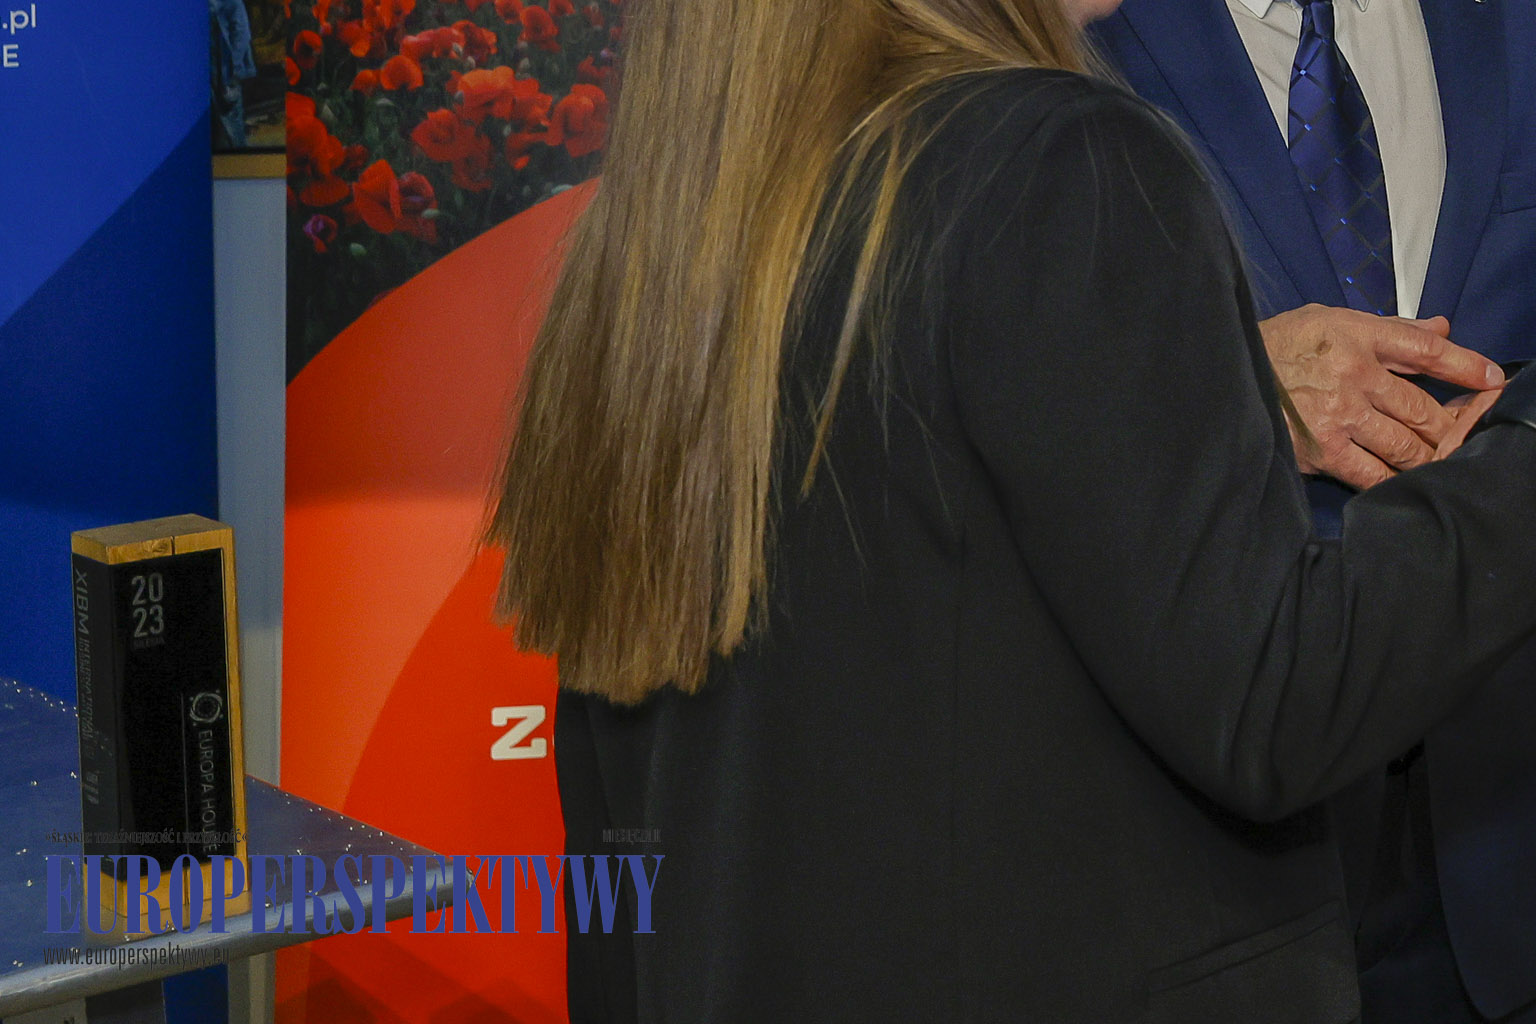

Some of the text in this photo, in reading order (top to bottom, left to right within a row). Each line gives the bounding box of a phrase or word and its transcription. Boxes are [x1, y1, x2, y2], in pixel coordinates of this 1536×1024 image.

[131, 574, 164, 606] 20
[133, 605, 165, 638] 23
[490, 705, 548, 761] Z
[198, 729, 215, 793] EUROPA
